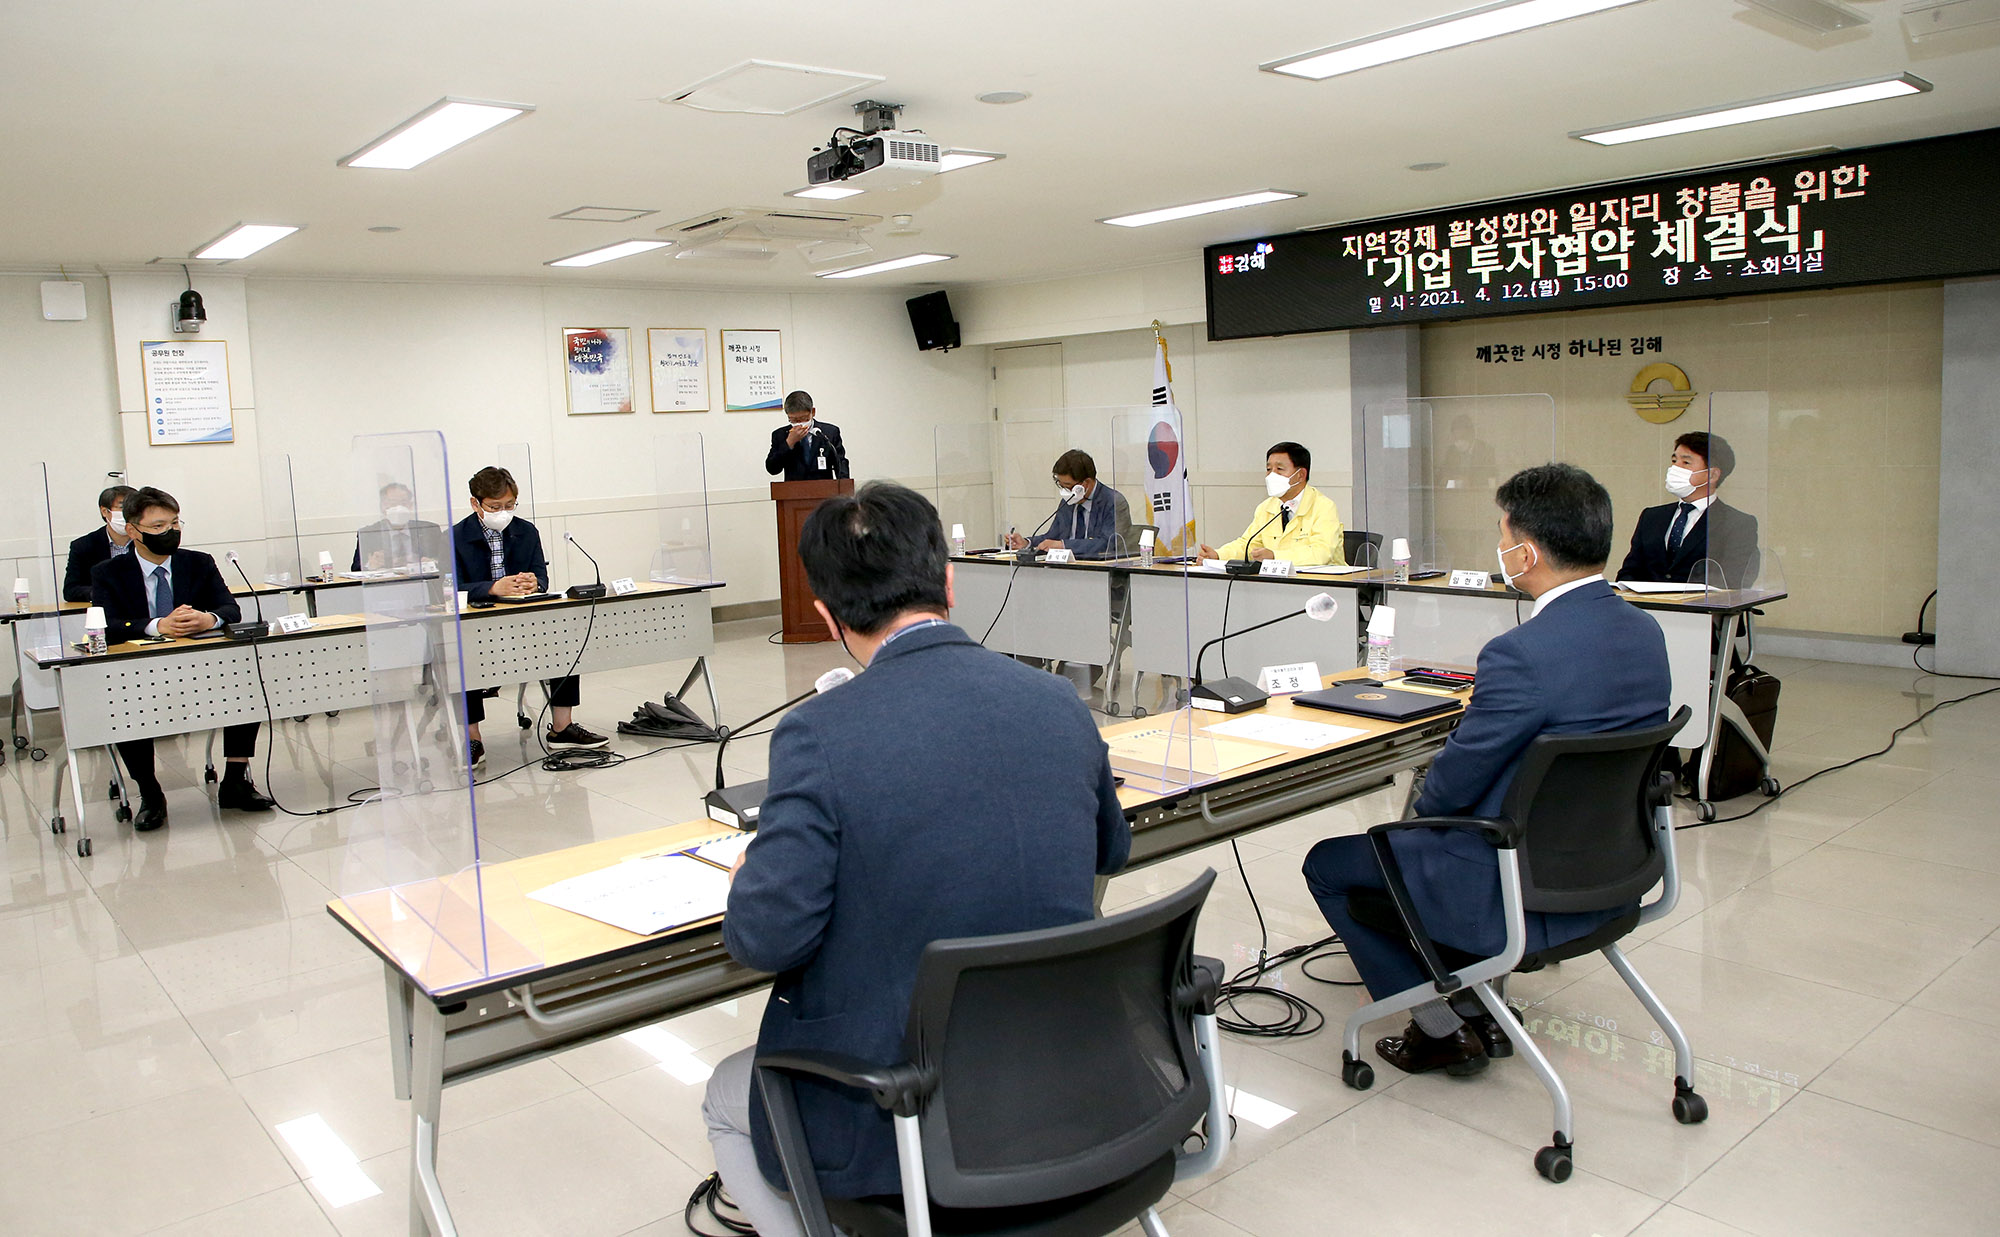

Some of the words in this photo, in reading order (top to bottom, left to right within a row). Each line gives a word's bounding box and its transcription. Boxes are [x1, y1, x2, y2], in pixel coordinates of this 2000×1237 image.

[1342, 225, 1436, 260] 지역경제
[1448, 208, 1559, 248] 활성화와
[1569, 193, 1660, 232] 일자리
[1676, 177, 1777, 219] 창출을
[1793, 164, 1870, 204] 위한
[1234, 251, 1266, 273] 김해
[1467, 226, 1636, 284] 투자협약
[1420, 290, 1465, 307] 2021.
[1475, 287, 1491, 301] 4.
[1573, 273, 1629, 292] 15:00
[1740, 252, 1824, 277] 소회의실
[151, 349, 170, 357] 공무원
[1475, 344, 1526, 363] 깨끗한
[1531, 342, 1561, 360] 시정
[1568, 338, 1622, 357] 하나된
[1630, 336, 1663, 355] 김해
